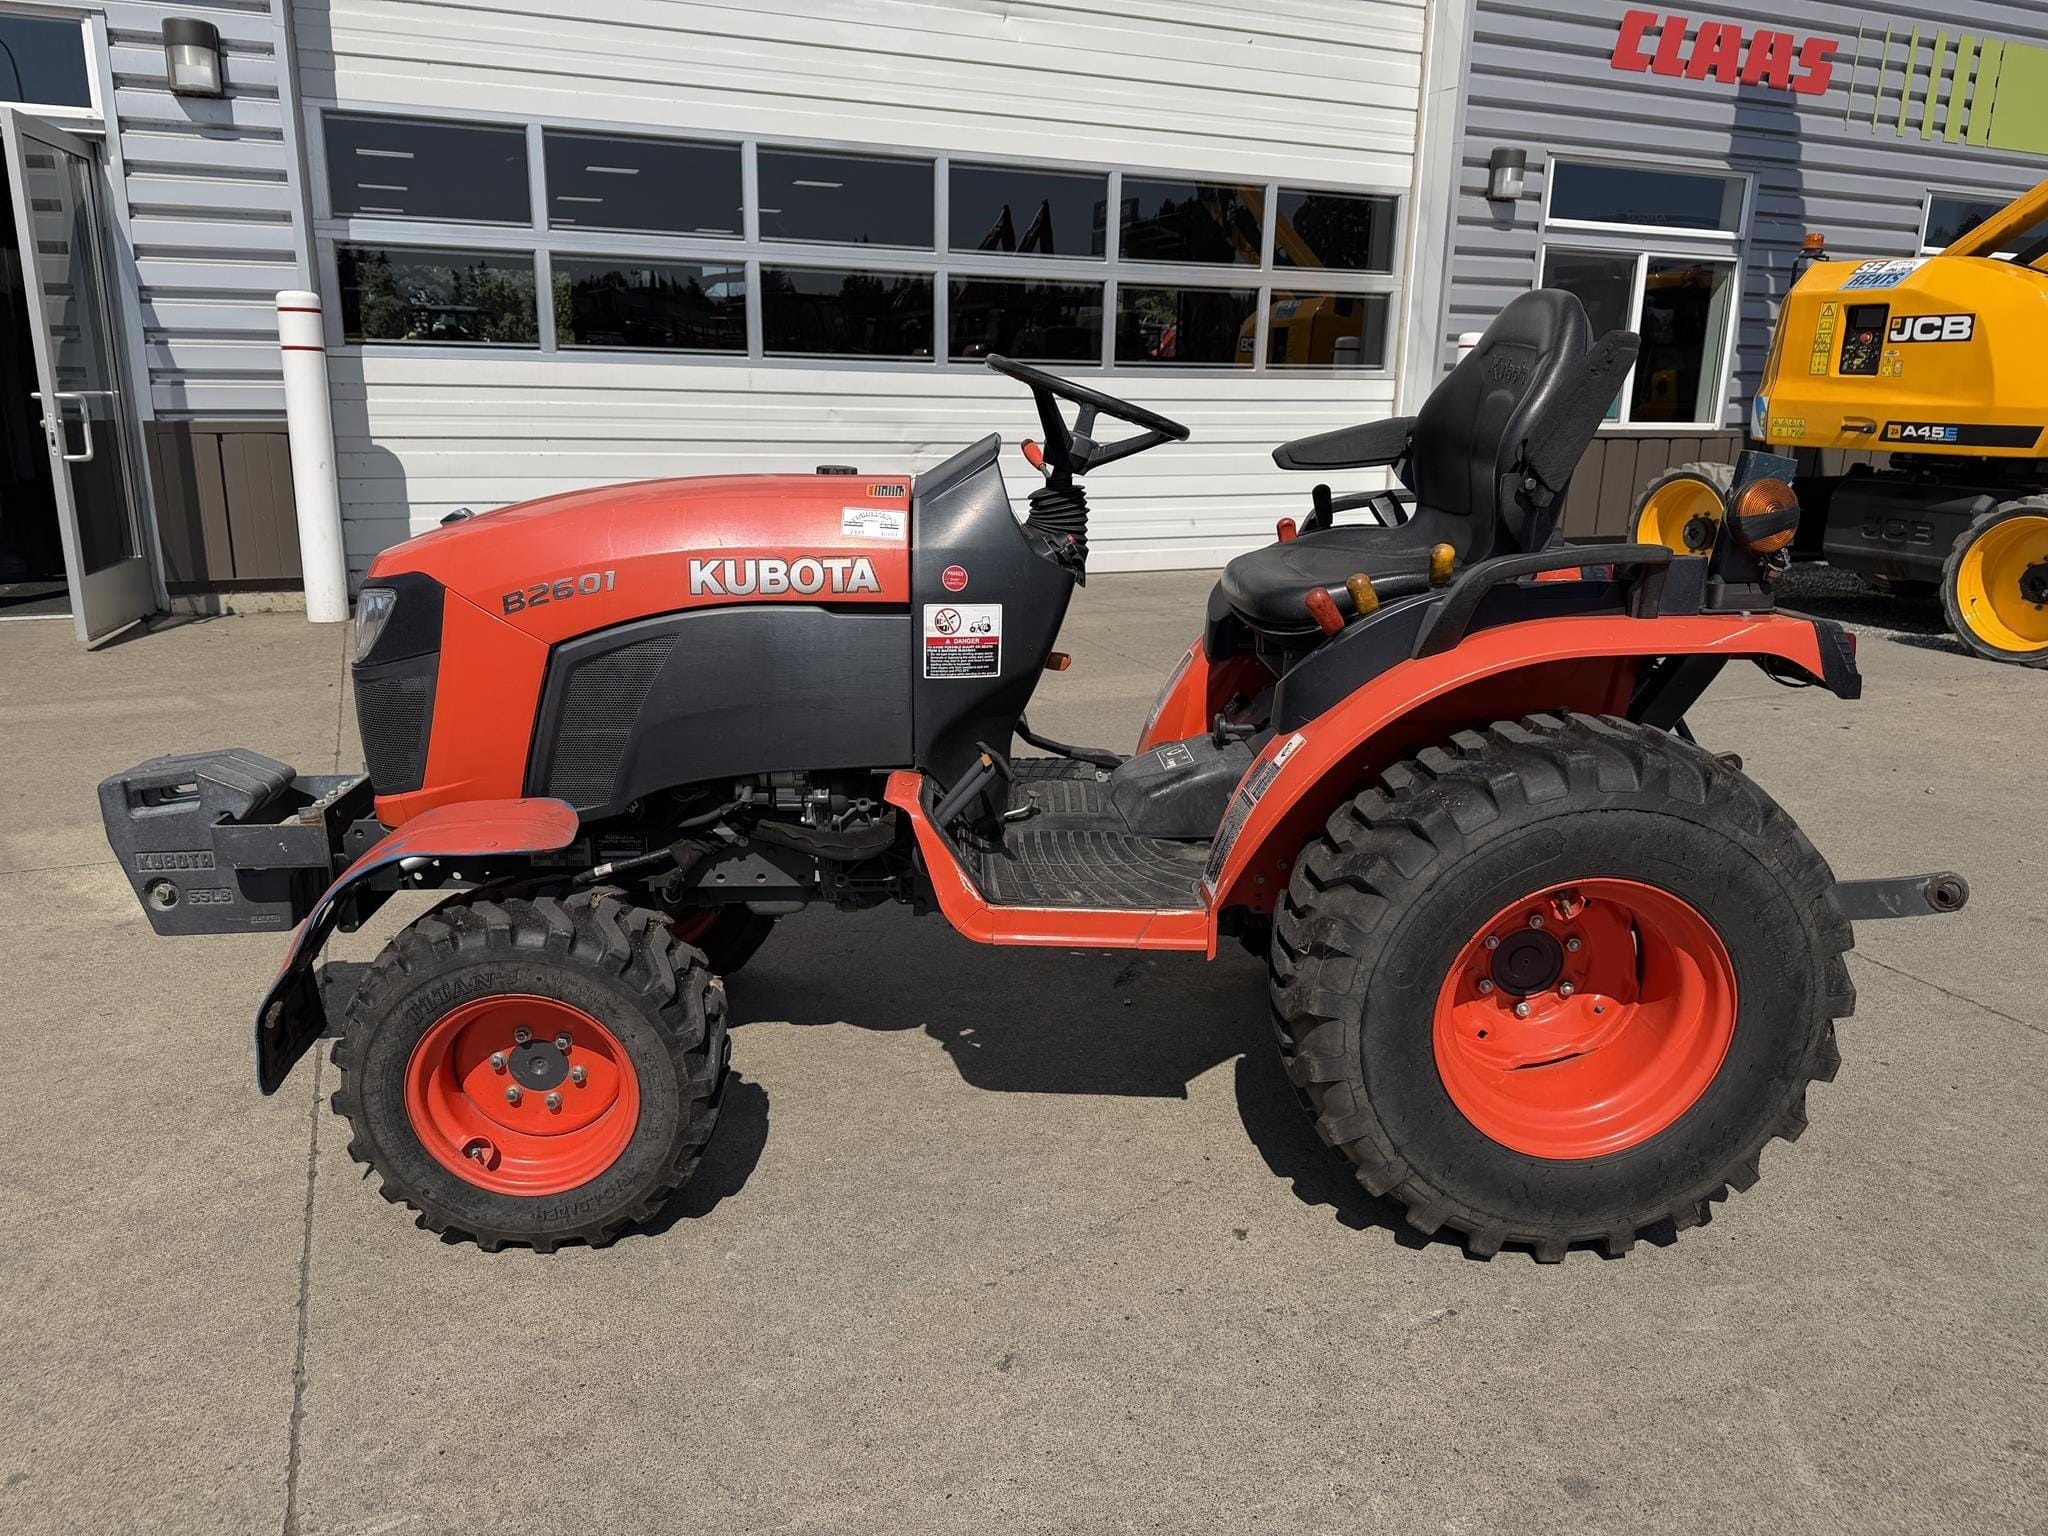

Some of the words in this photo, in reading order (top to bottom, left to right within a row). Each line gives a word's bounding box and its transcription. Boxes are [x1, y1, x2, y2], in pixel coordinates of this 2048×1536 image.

[1611, 10, 1839, 96] CLAAS
[1847, 271, 1907, 286] RENTS
[1890, 315, 1972, 341] JCB
[1902, 424, 1958, 439] A45E
[1860, 517, 1934, 546] JCB
[689, 556, 882, 595] KUBOTA
[502, 571, 616, 615] B2601
[953, 637, 980, 645] DANGER
[137, 852, 214, 871] KUBOTA
[187, 888, 232, 904] 55LB
